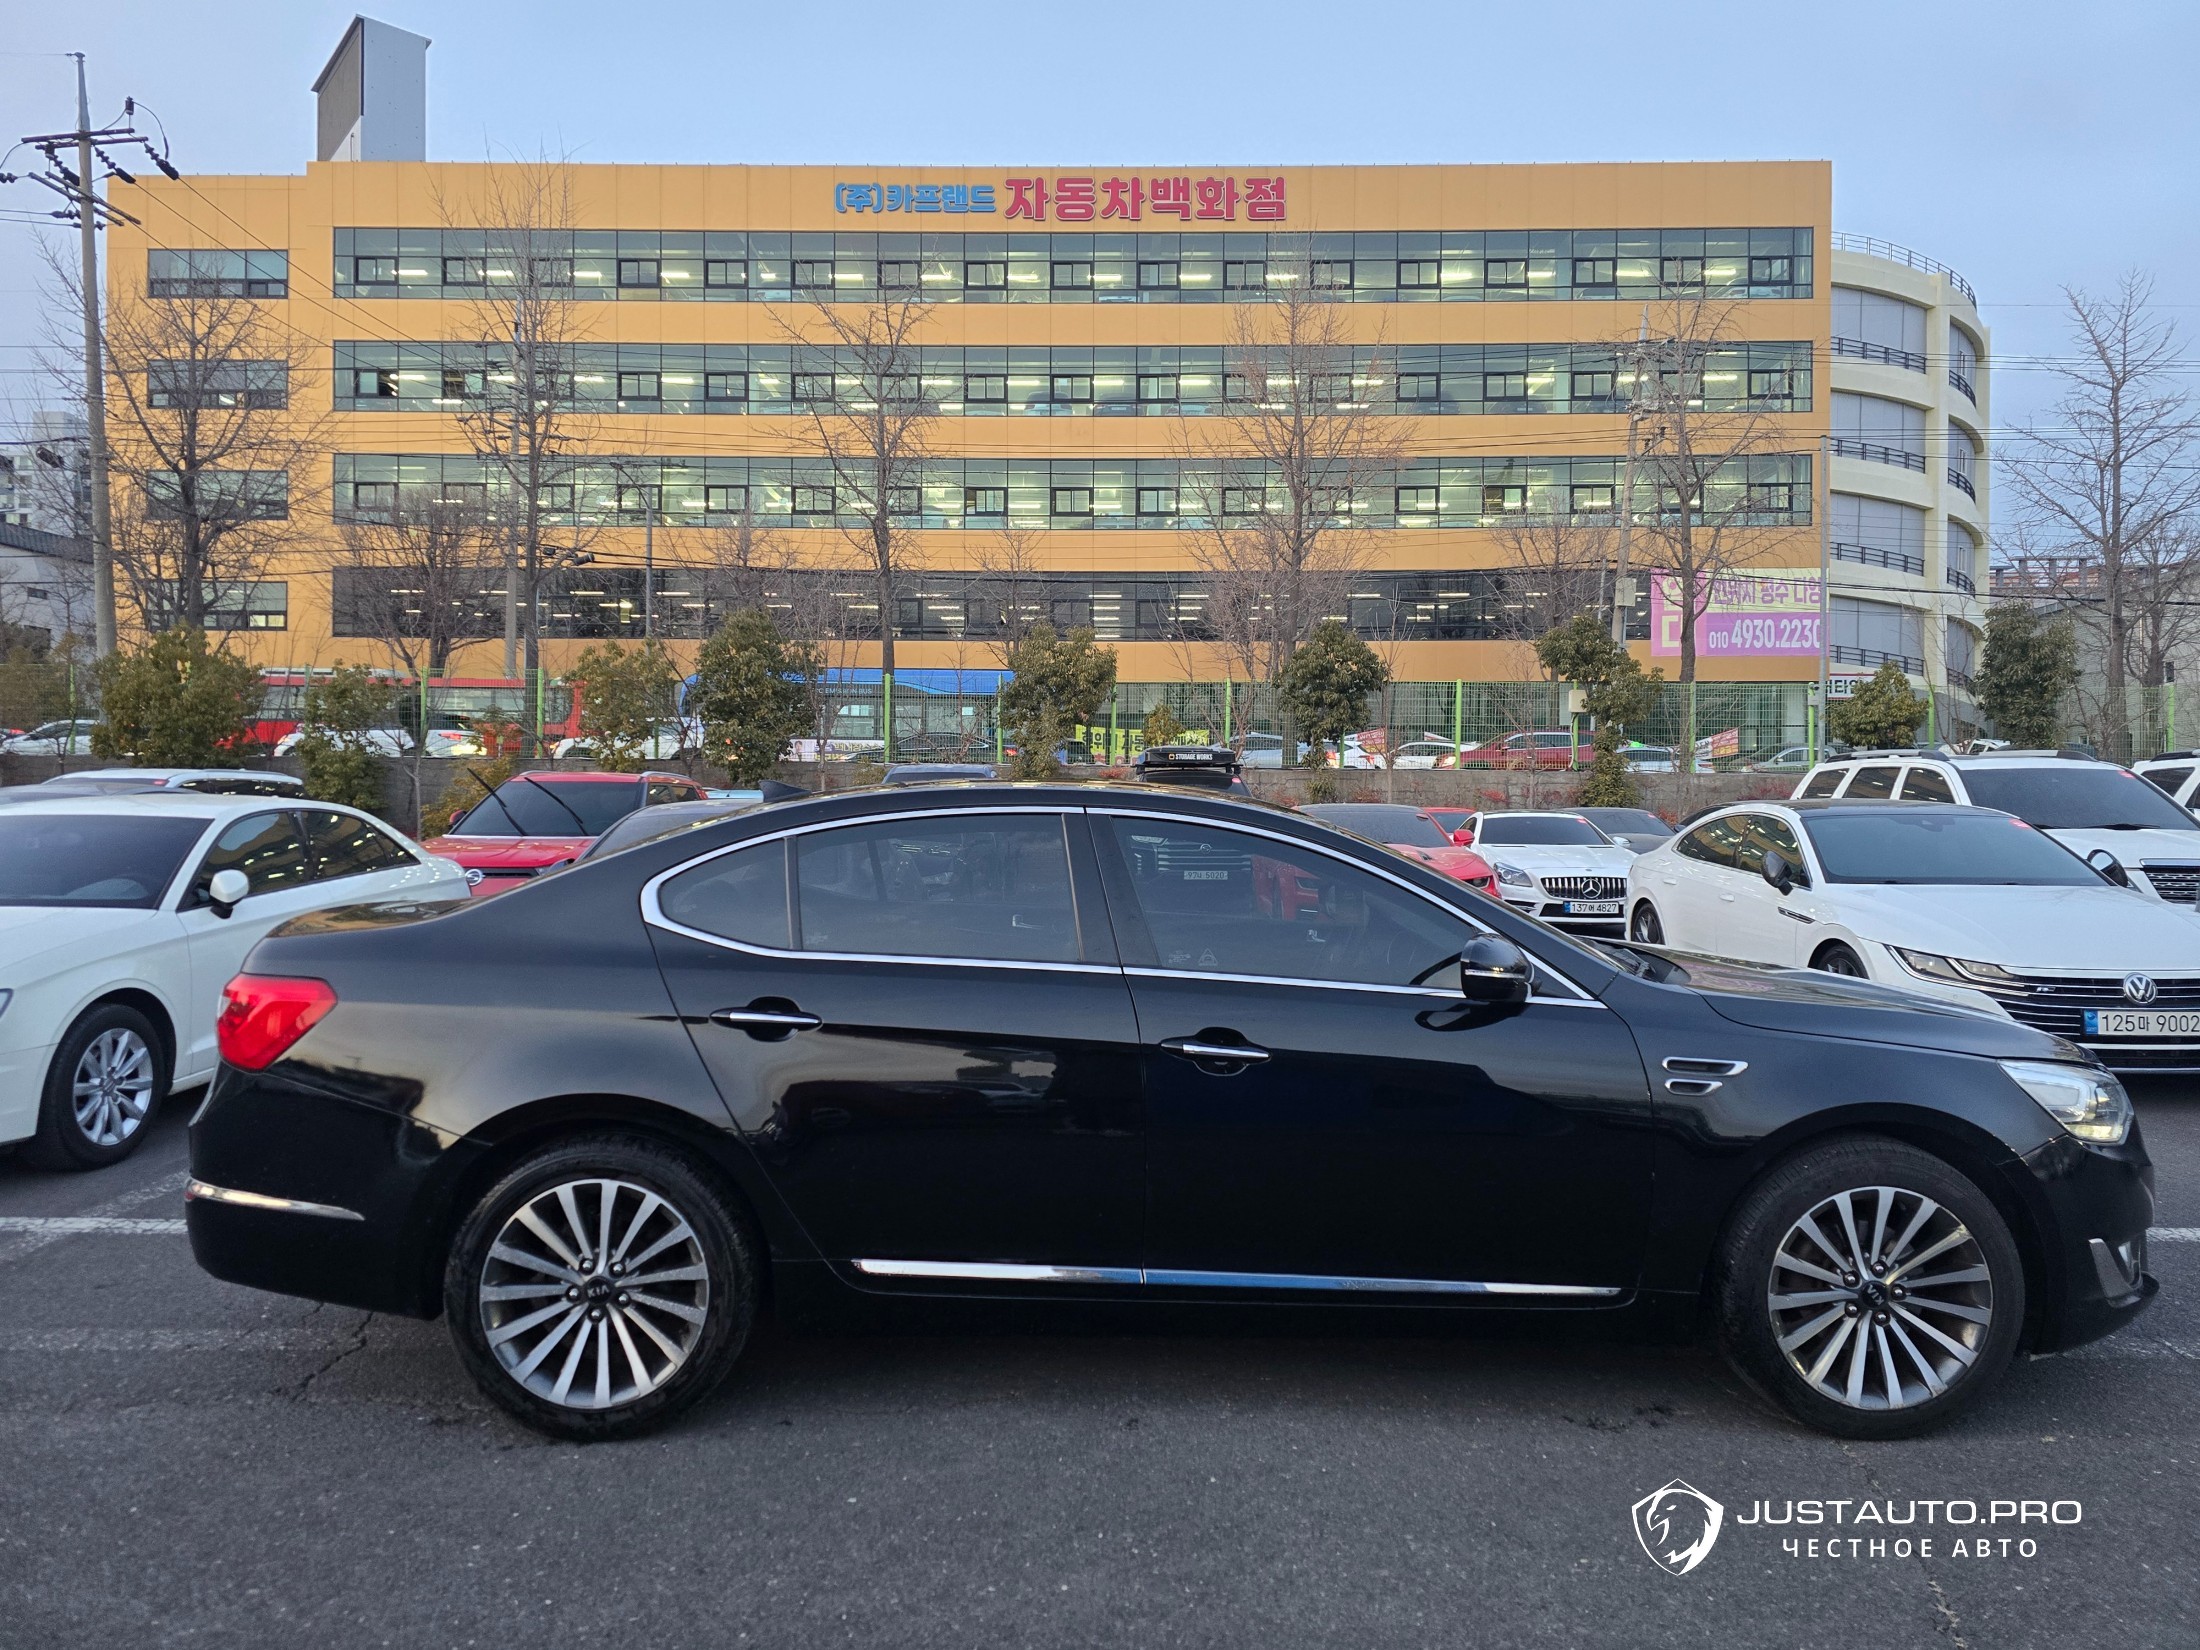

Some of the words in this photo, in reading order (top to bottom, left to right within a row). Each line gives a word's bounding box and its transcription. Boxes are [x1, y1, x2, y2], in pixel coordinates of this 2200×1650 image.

[834, 182, 997, 213] (주)카프랜드
[1003, 176, 1287, 221] 자동차백화점
[1708, 631, 1729, 649] 010
[1731, 618, 1821, 649] 4930.2230
[1596, 903, 1617, 913] 4827
[2101, 1014, 2150, 1032] 125마
[2156, 1014, 2200, 1033] 9002
[586, 1284, 610, 1298] KIA
